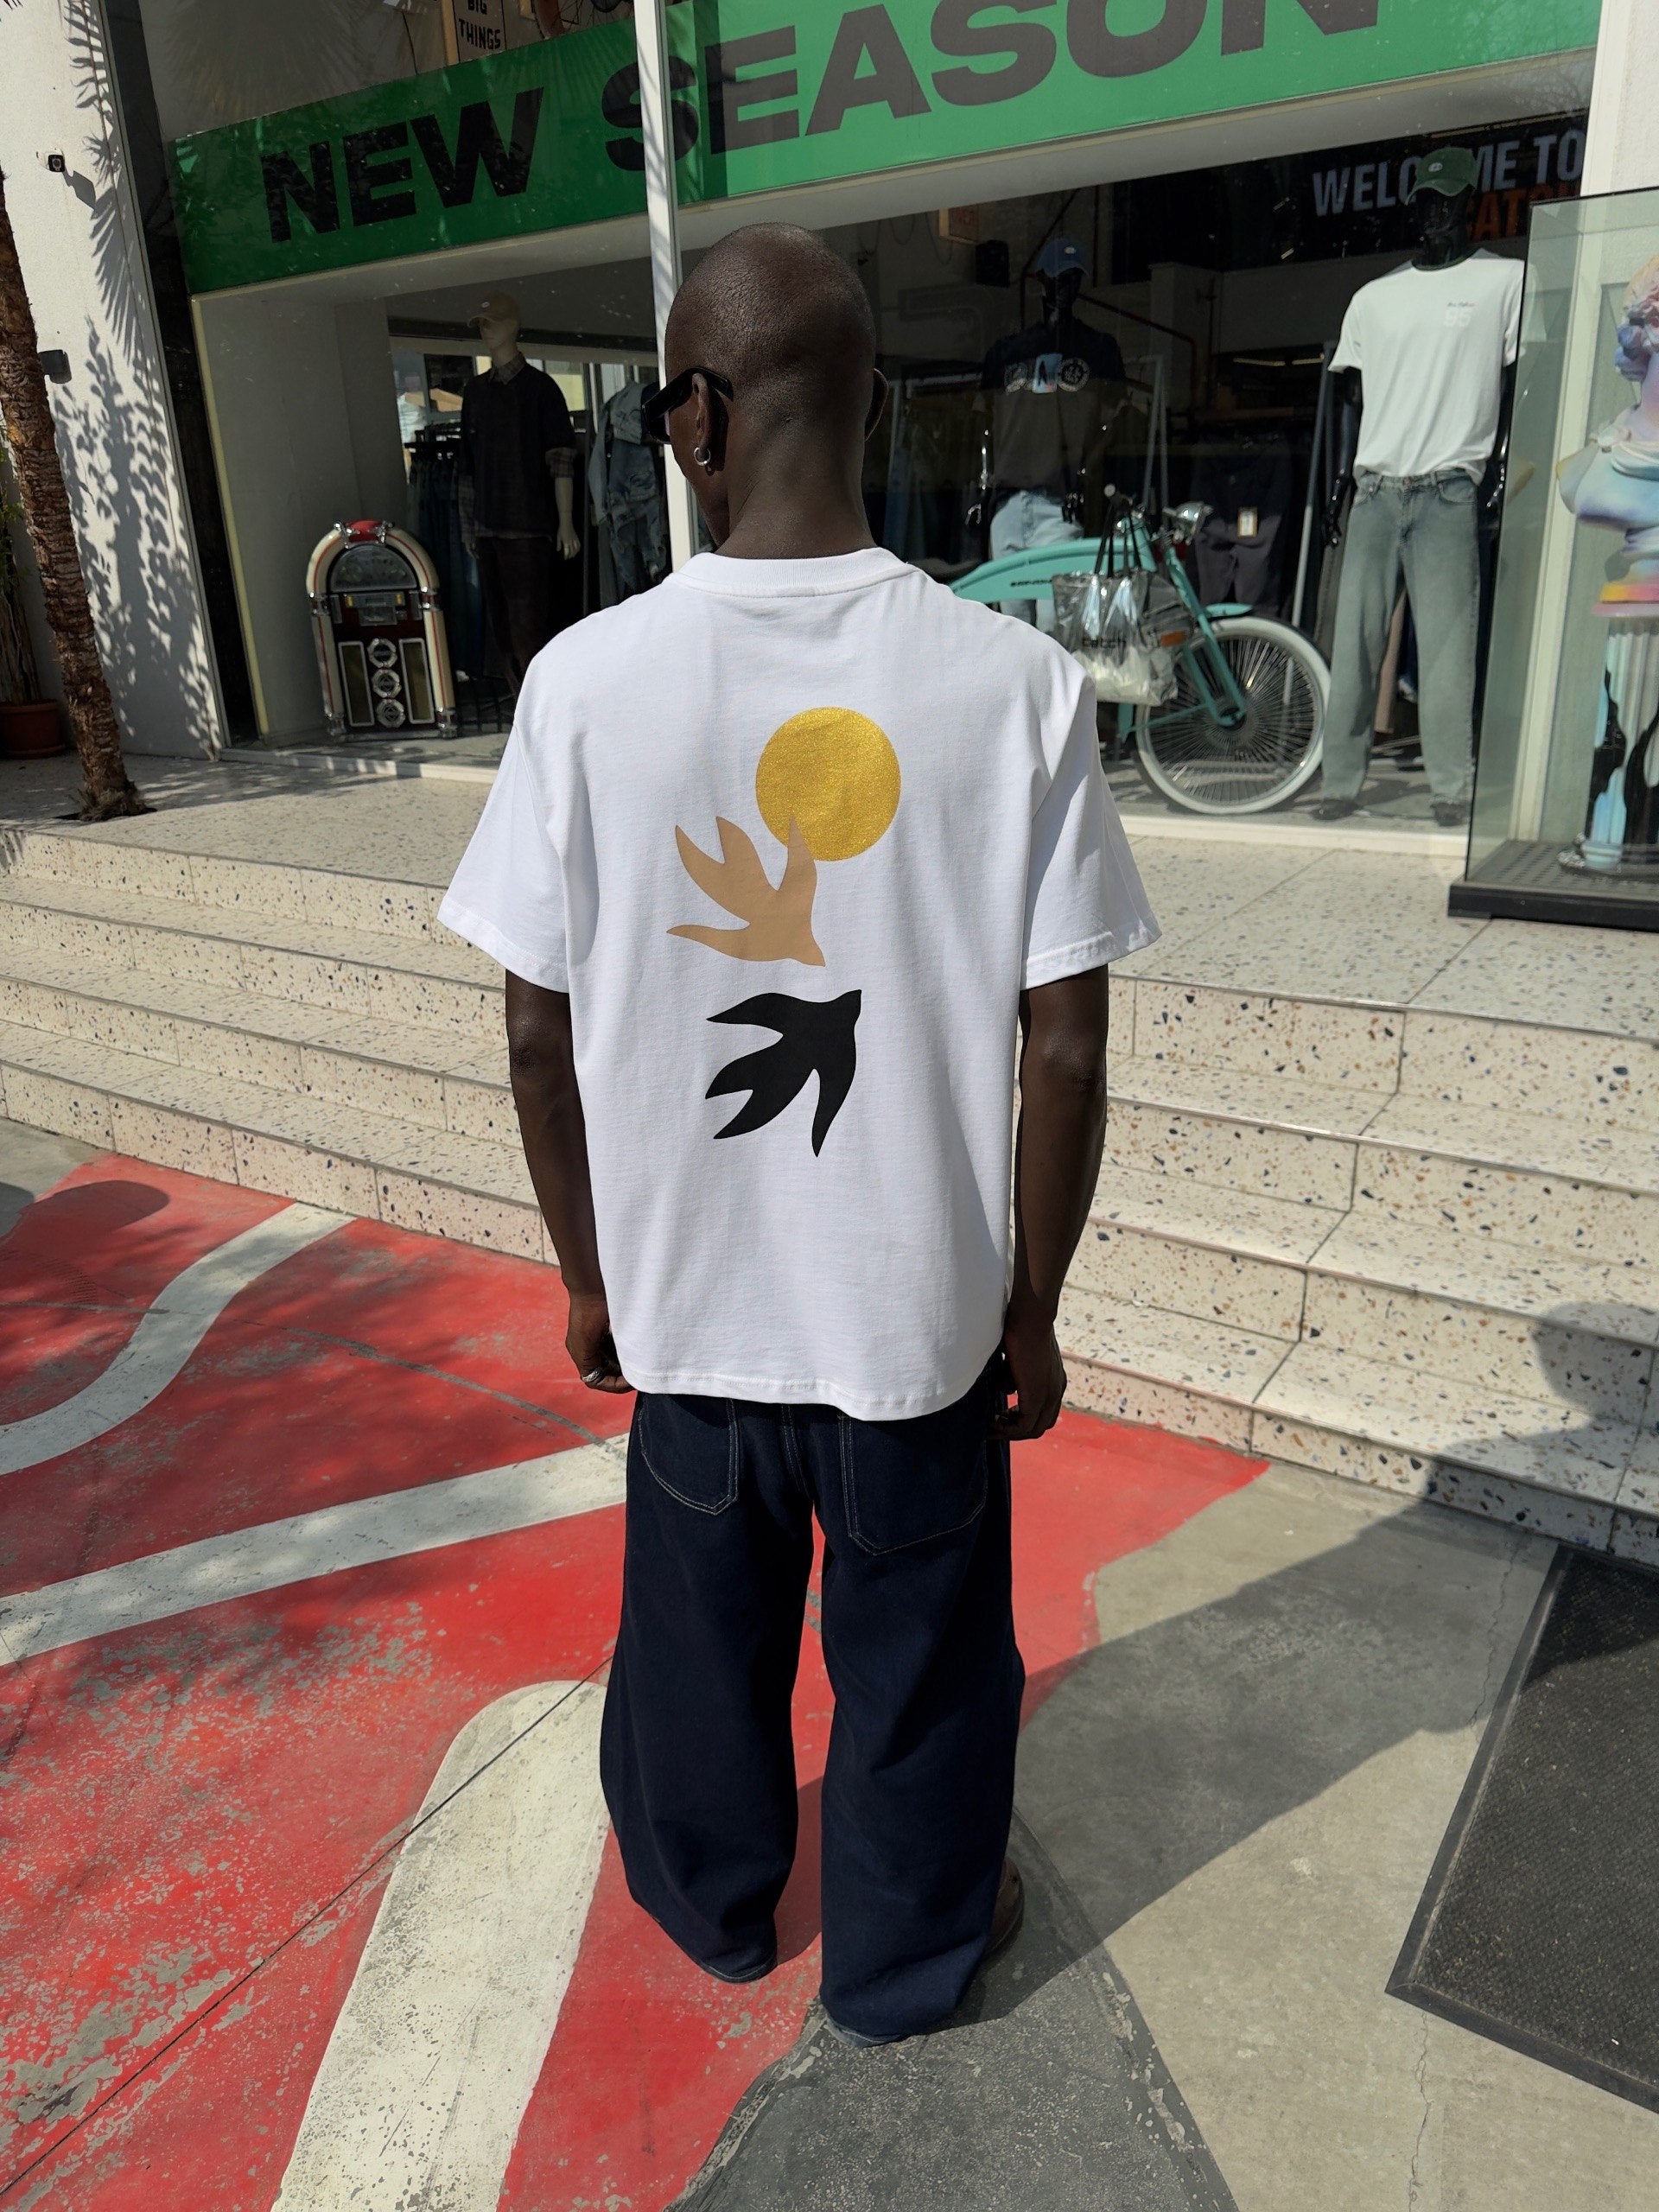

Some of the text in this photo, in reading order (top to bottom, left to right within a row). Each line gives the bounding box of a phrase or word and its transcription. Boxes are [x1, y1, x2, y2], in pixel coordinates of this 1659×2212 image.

[458, 18, 501, 50] THINGS
[261, 86, 543, 244] NEW
[1312, 140, 1520, 218] WELCME
[1533, 128, 1586, 185] TO
